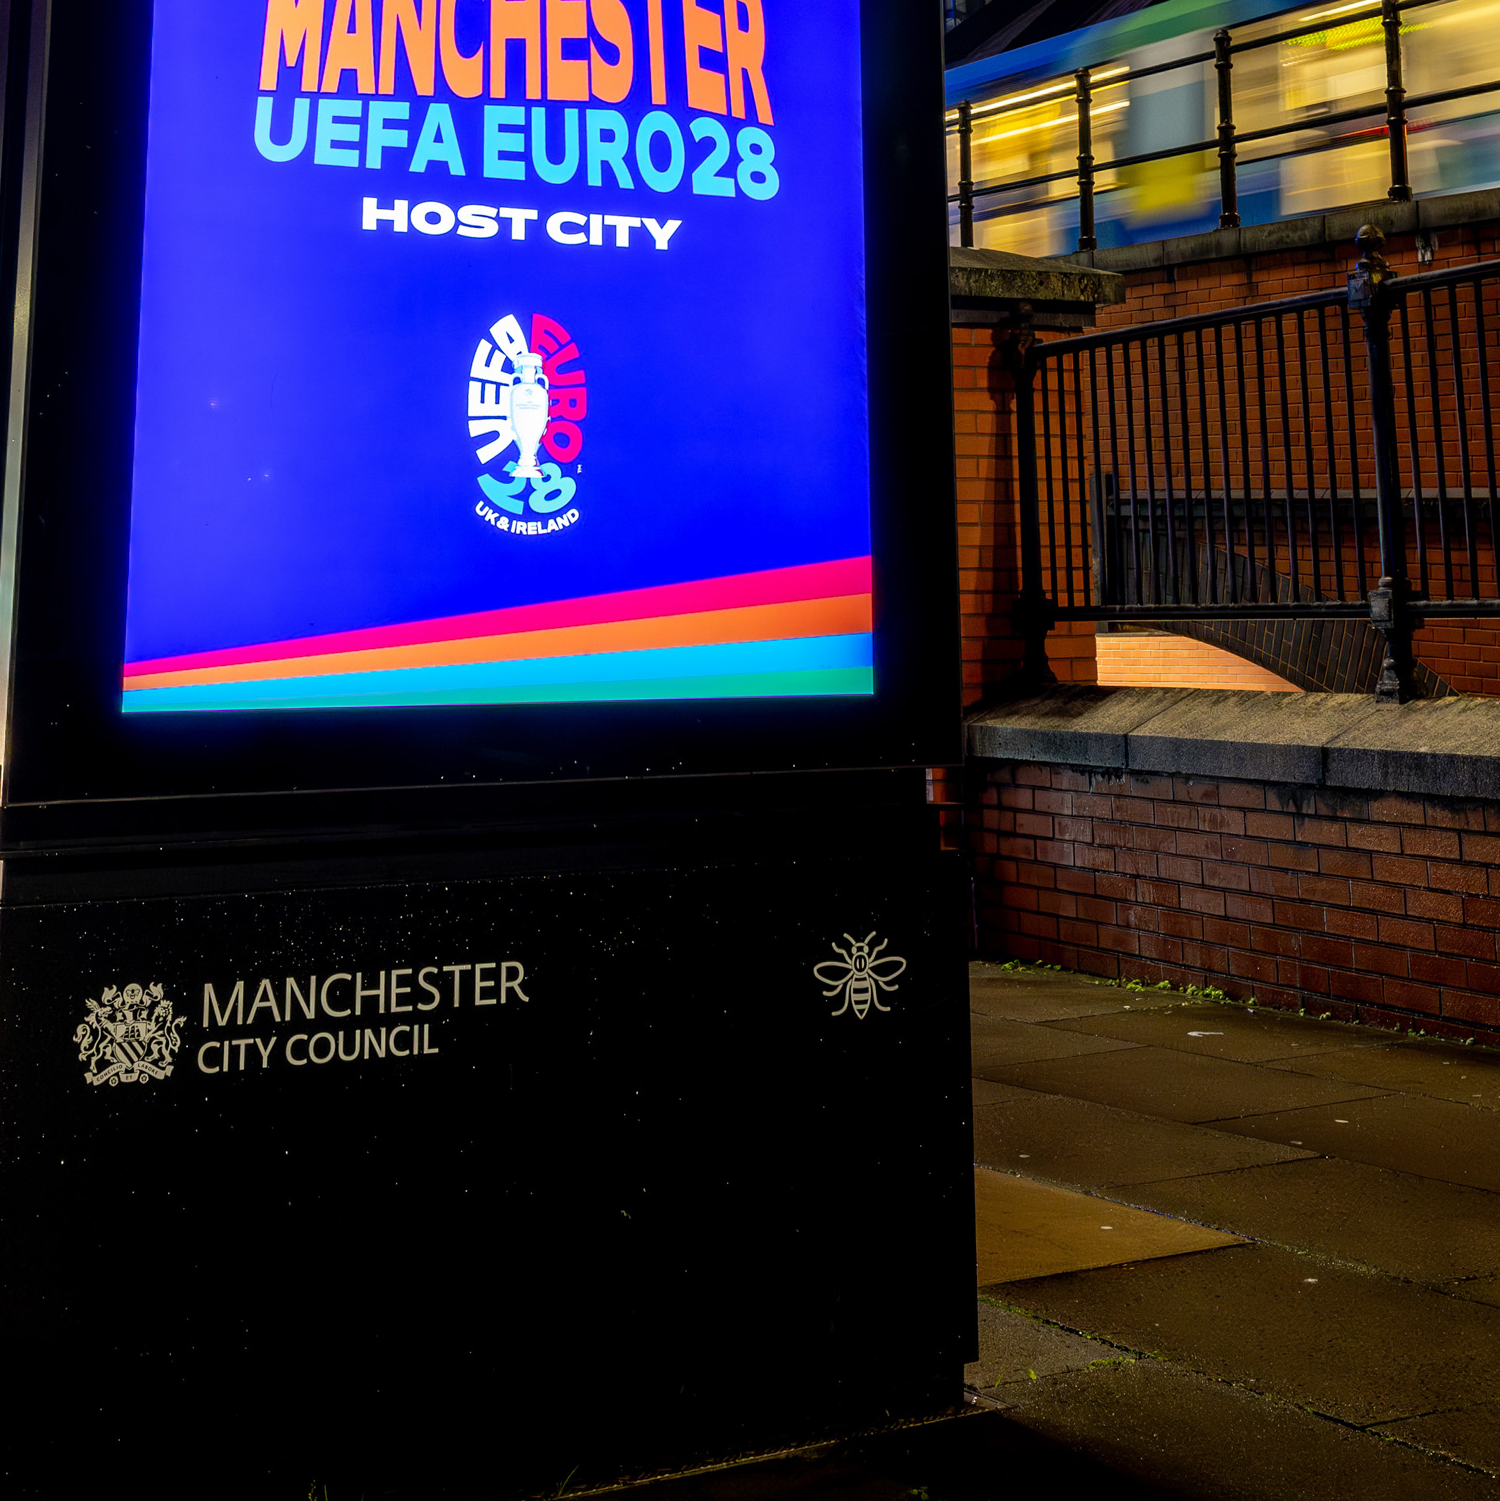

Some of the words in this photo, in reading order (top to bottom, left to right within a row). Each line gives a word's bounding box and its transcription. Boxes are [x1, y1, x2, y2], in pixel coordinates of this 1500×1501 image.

[253, 96, 467, 177] UEFA
[361, 196, 539, 241] HOST
[545, 210, 683, 250] CITY
[467, 313, 529, 465] UEFA
[530, 313, 588, 463] EURO
[476, 460, 577, 515] 28
[203, 961, 530, 1028] MANCHESTER
[197, 1036, 277, 1074] CITY
[285, 1024, 440, 1066] COUNCIL
